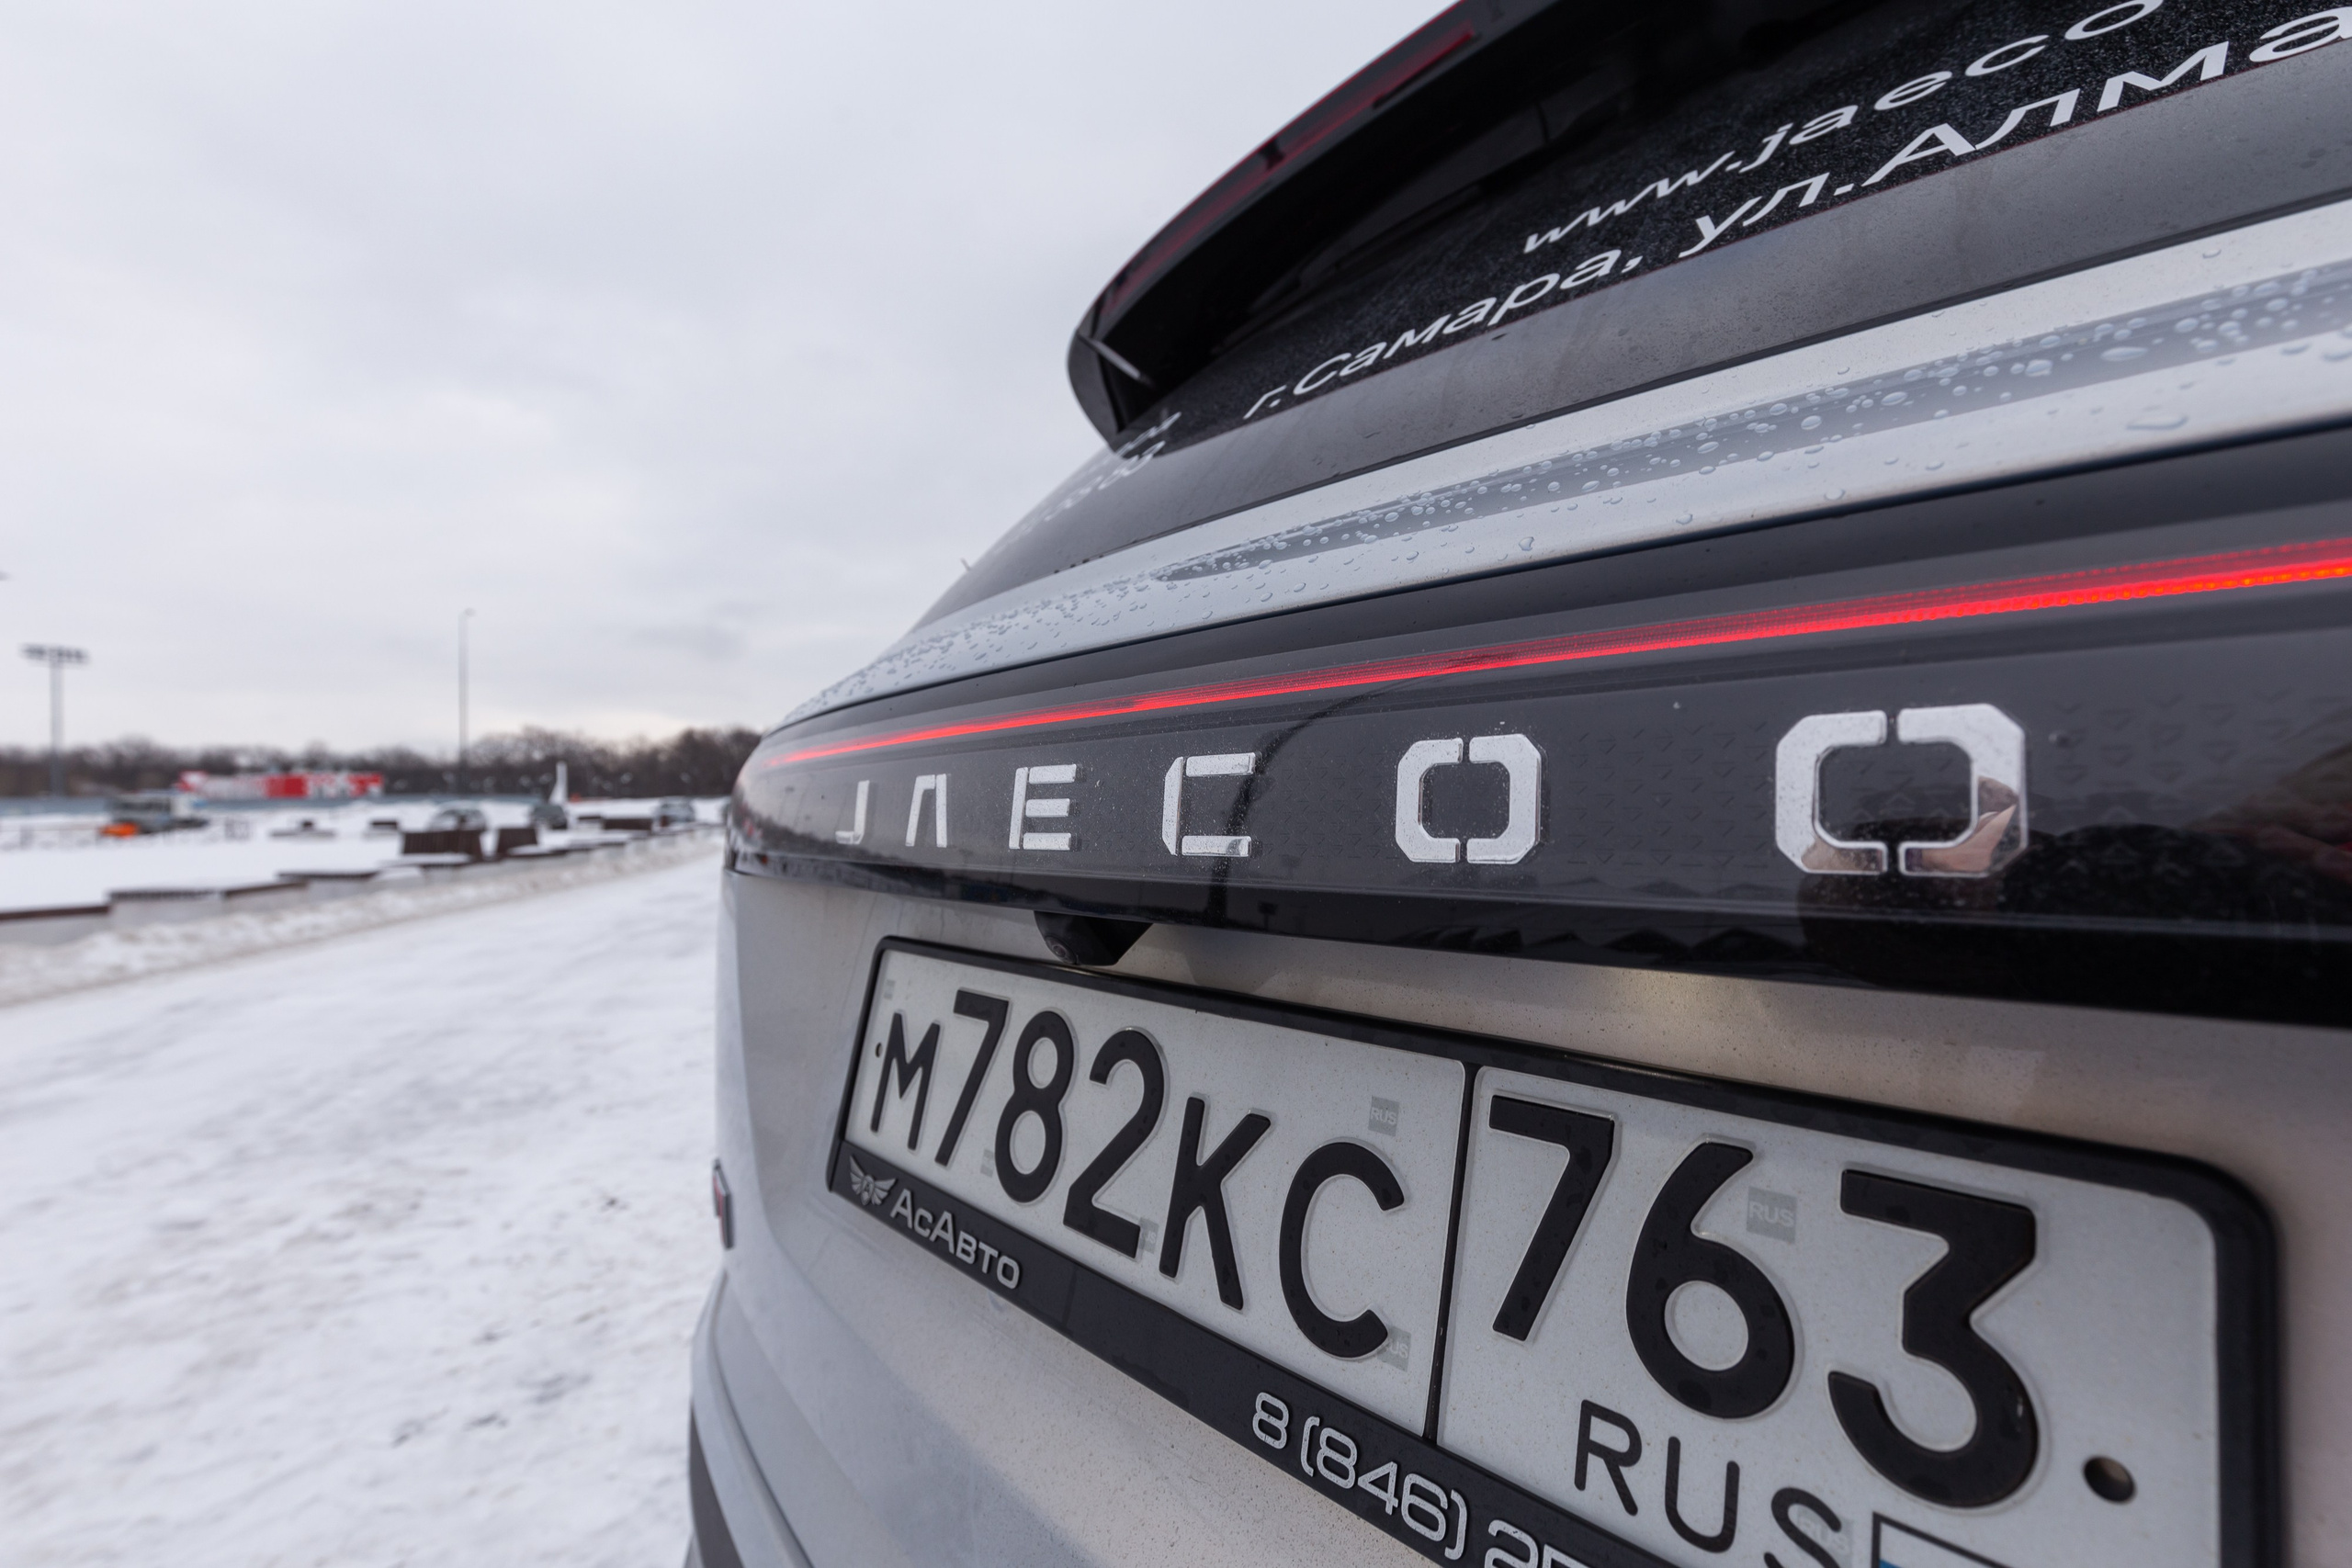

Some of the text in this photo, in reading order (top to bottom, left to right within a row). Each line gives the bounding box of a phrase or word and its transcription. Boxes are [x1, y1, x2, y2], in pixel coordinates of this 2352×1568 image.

[1243, 249, 1643, 420] г.Самара,
[834, 703, 2030, 878] JAECOO
[1748, 1201, 1794, 1227] RUS
[1488, 1094, 2040, 1508] 763
[1251, 1392, 1290, 1450] 8
[1299, 1416, 1468, 1561] (846)
[1574, 1399, 1843, 1568] RUS
